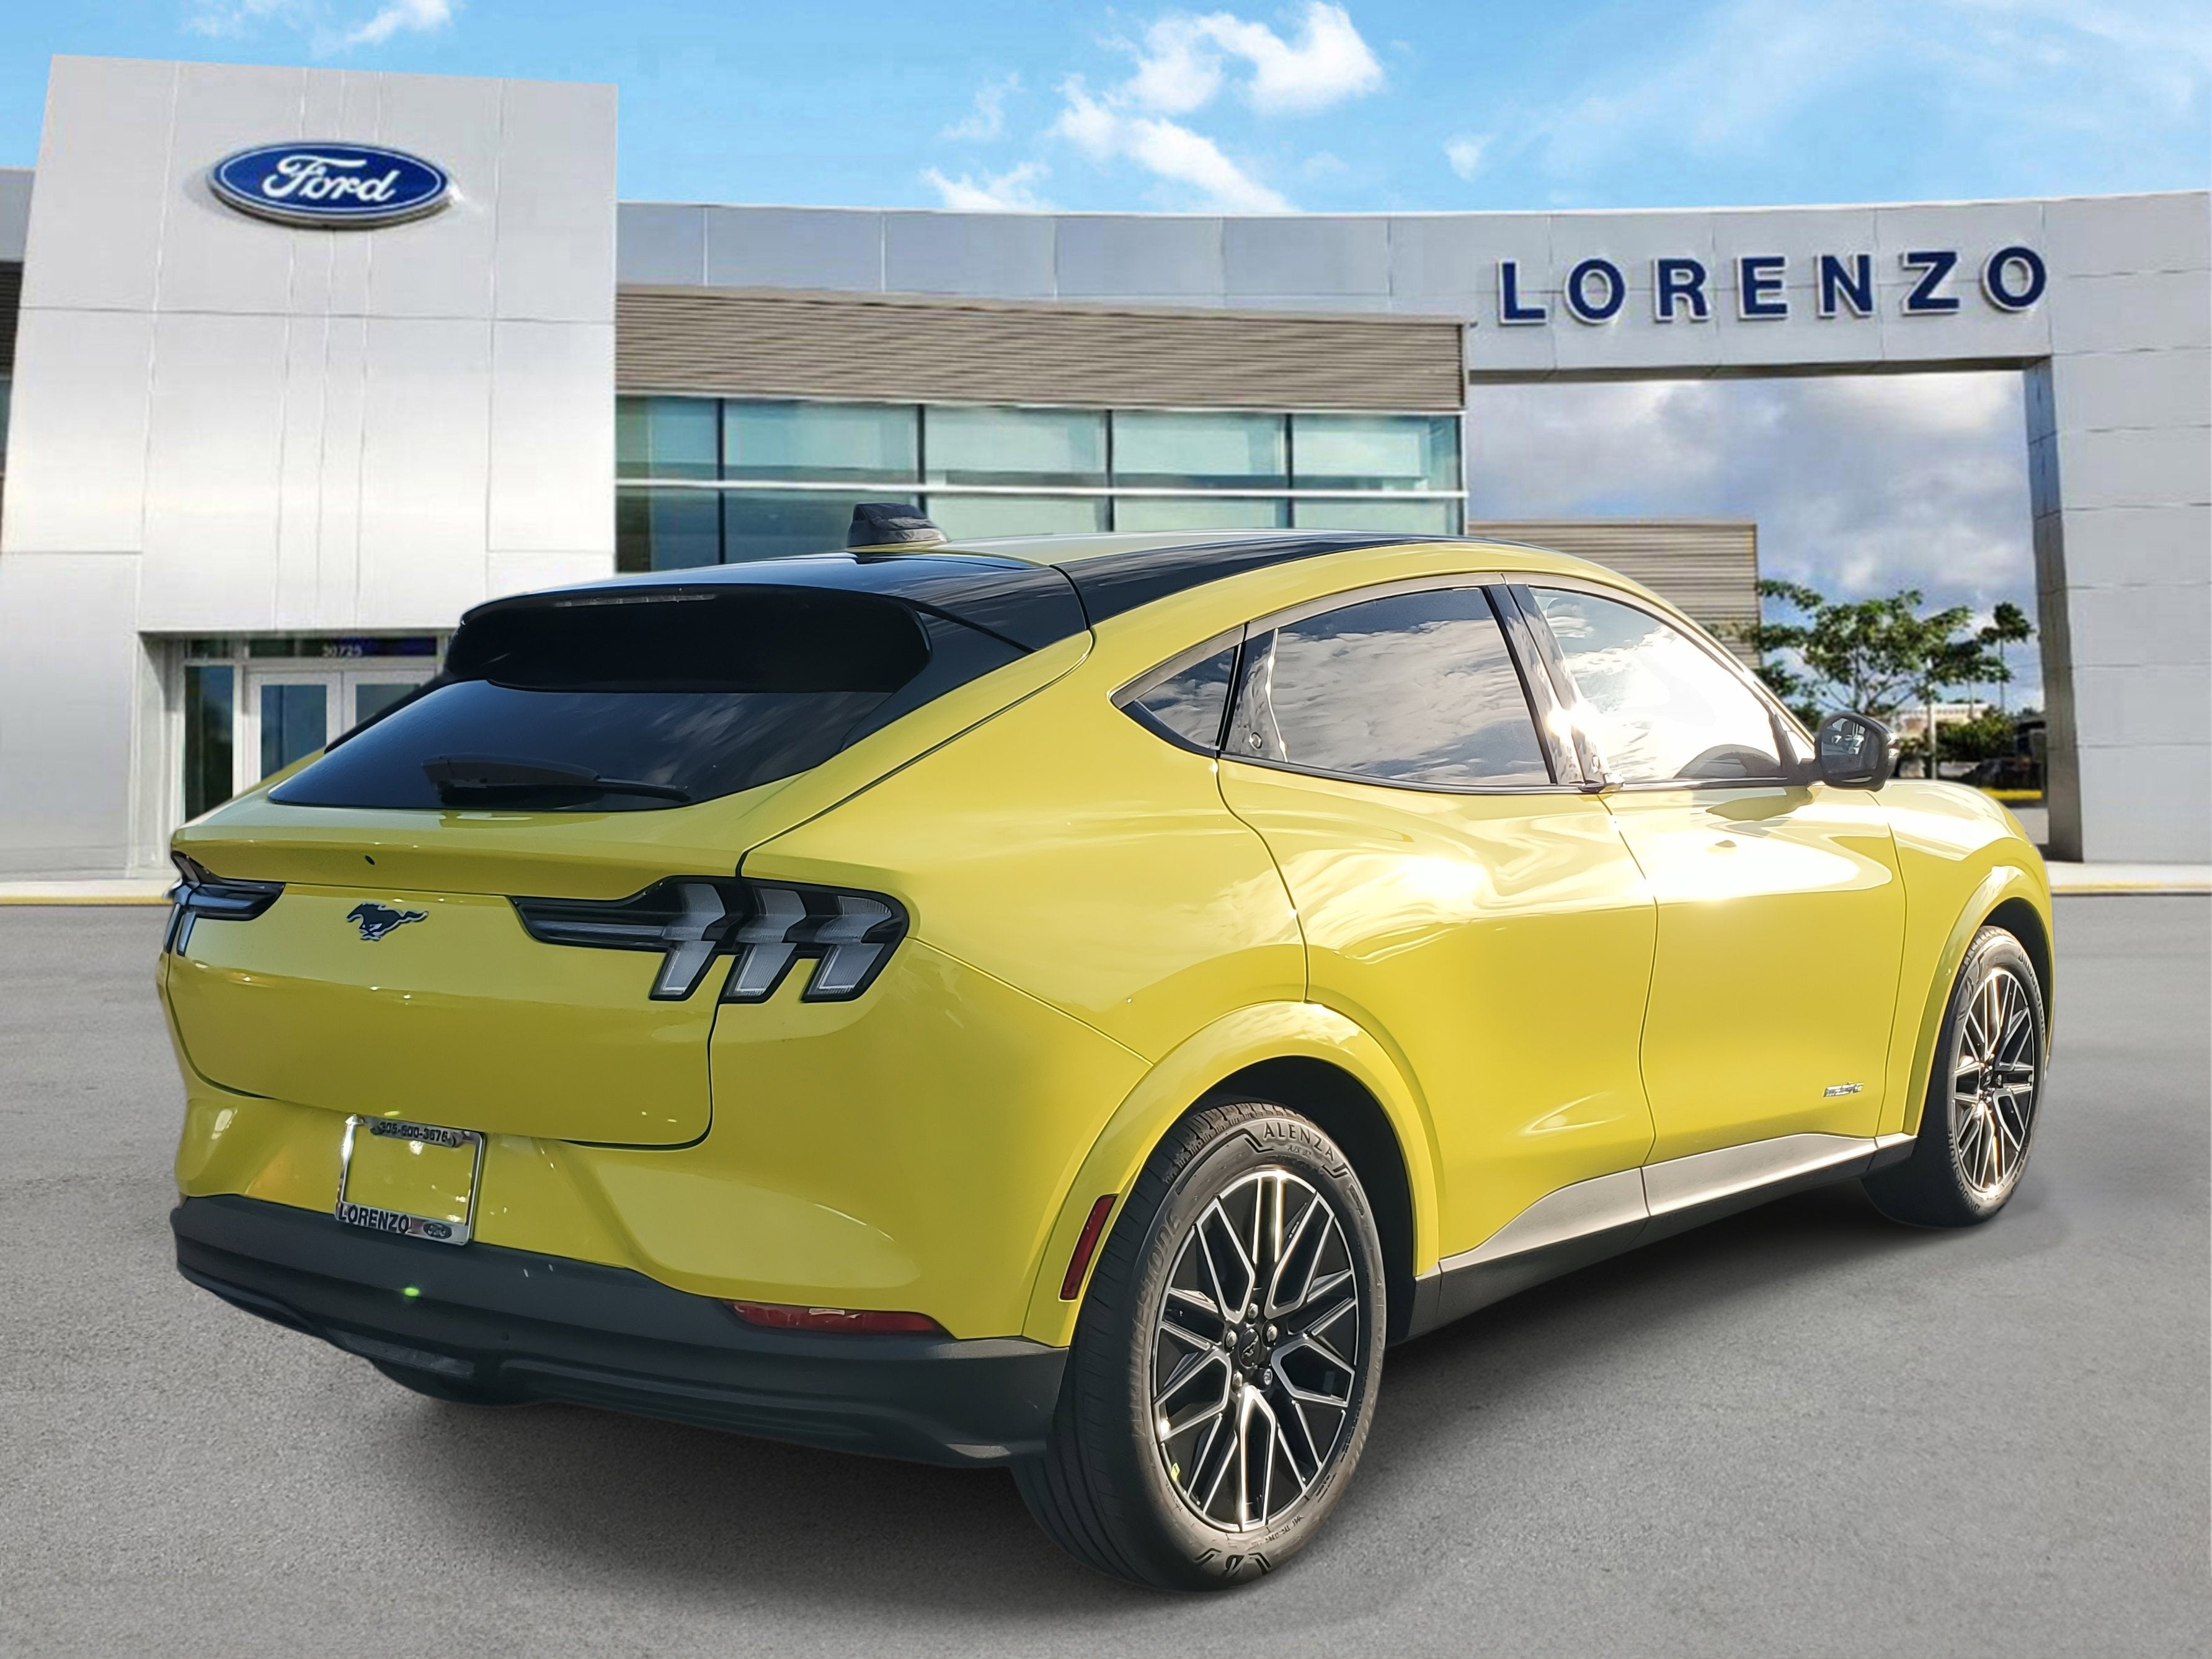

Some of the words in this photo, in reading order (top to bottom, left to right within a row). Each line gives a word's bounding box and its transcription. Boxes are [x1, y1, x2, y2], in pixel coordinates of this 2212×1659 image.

[262, 155, 401, 202] Ford
[1498, 247, 2047, 325] LORENZO
[1264, 1124, 1335, 1162] ALENZA
[339, 1202, 412, 1234] LORENZO
